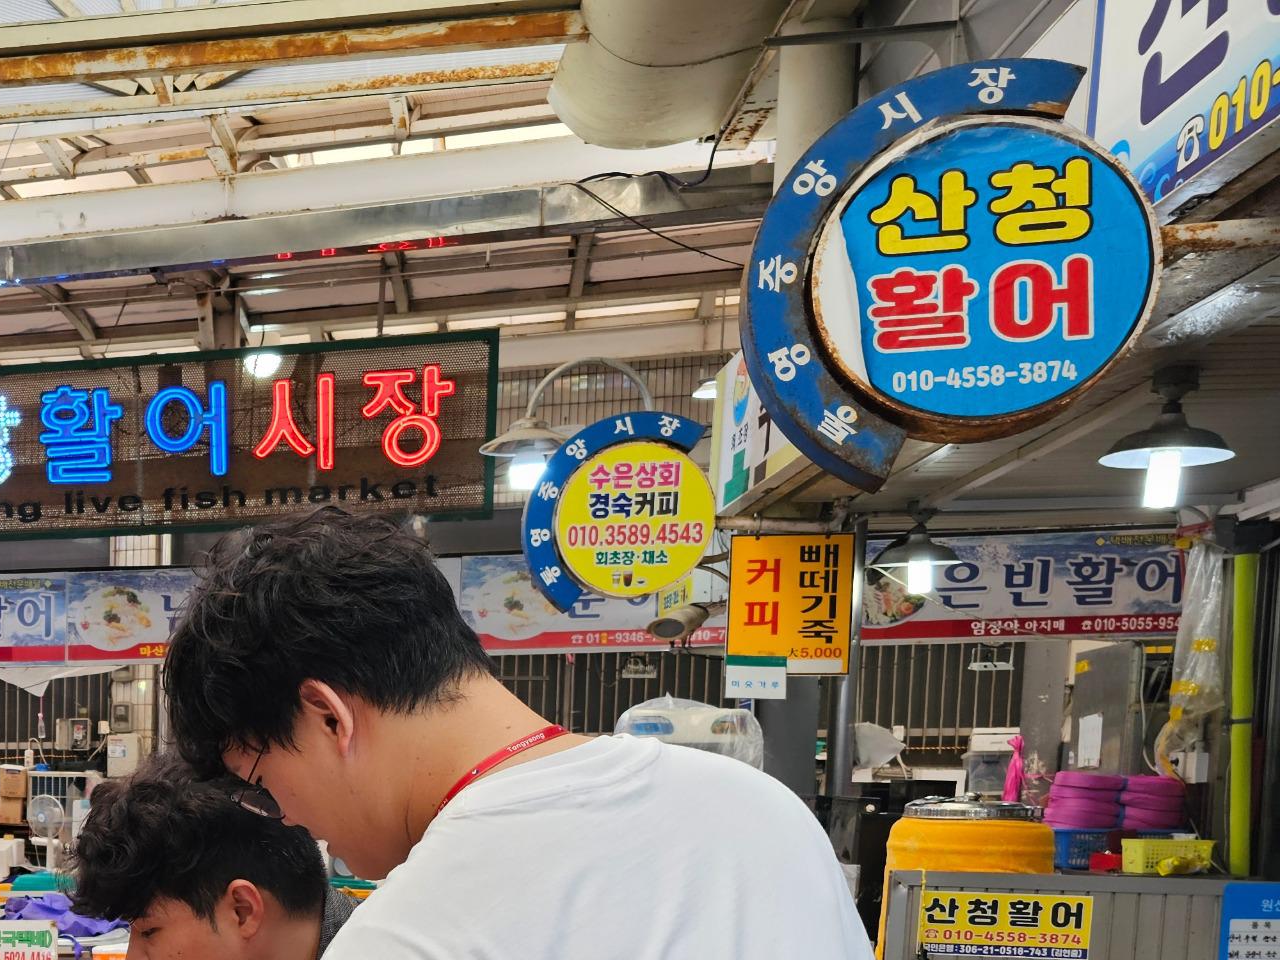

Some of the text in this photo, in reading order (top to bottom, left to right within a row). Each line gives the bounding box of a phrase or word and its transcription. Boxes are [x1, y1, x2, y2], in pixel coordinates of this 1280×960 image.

[868, 156, 1094, 258] 산청
[866, 252, 1096, 354] 활어
[891, 358, 1079, 394] 010-4558-3874
[63, 489, 144, 517] live
[162, 481, 248, 513] fish
[264, 472, 439, 507] market
[588, 461, 681, 490] 수은상회
[588, 491, 680, 520] 경숙커피
[567, 522, 704, 547] 010.3589.4543
[744, 558, 781, 636] 커피
[798, 543, 840, 644] 빼떼기죽
[935, 554, 1181, 609] 은빈활어
[924, 897, 1084, 930] 산청활어
[942, 929, 1082, 945] 010-4558-3874
